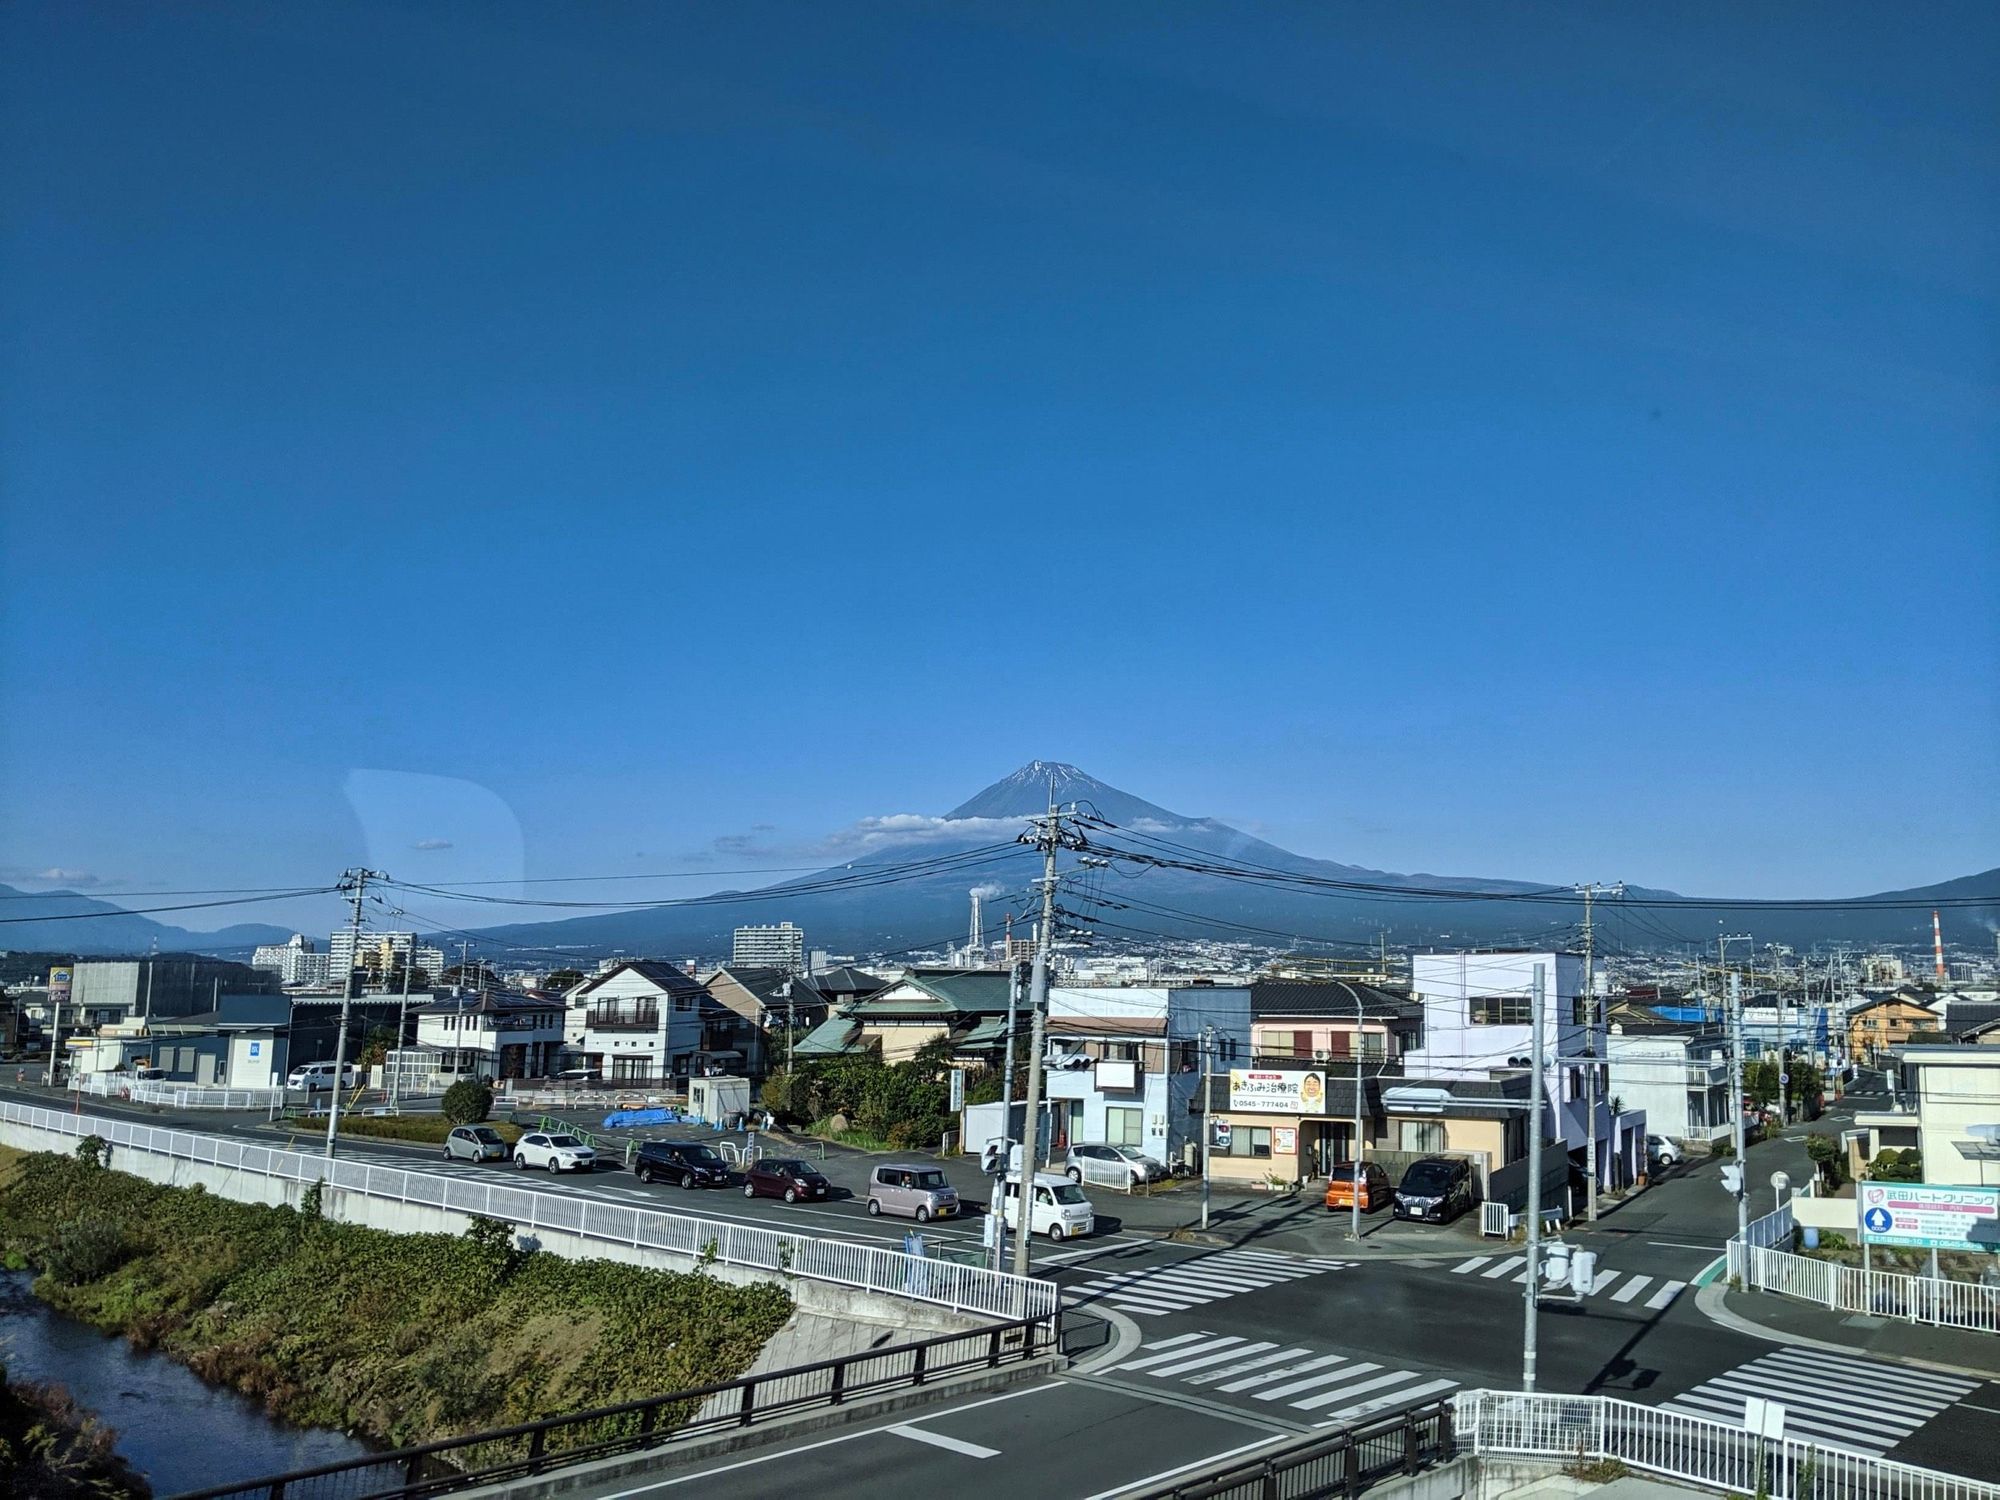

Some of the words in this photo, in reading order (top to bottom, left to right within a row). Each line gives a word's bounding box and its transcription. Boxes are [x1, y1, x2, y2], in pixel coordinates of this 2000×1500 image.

[1232, 1080, 1299, 1094] あきふみ治療院
[1887, 1191, 1995, 1205] 武田ハートクリニック
